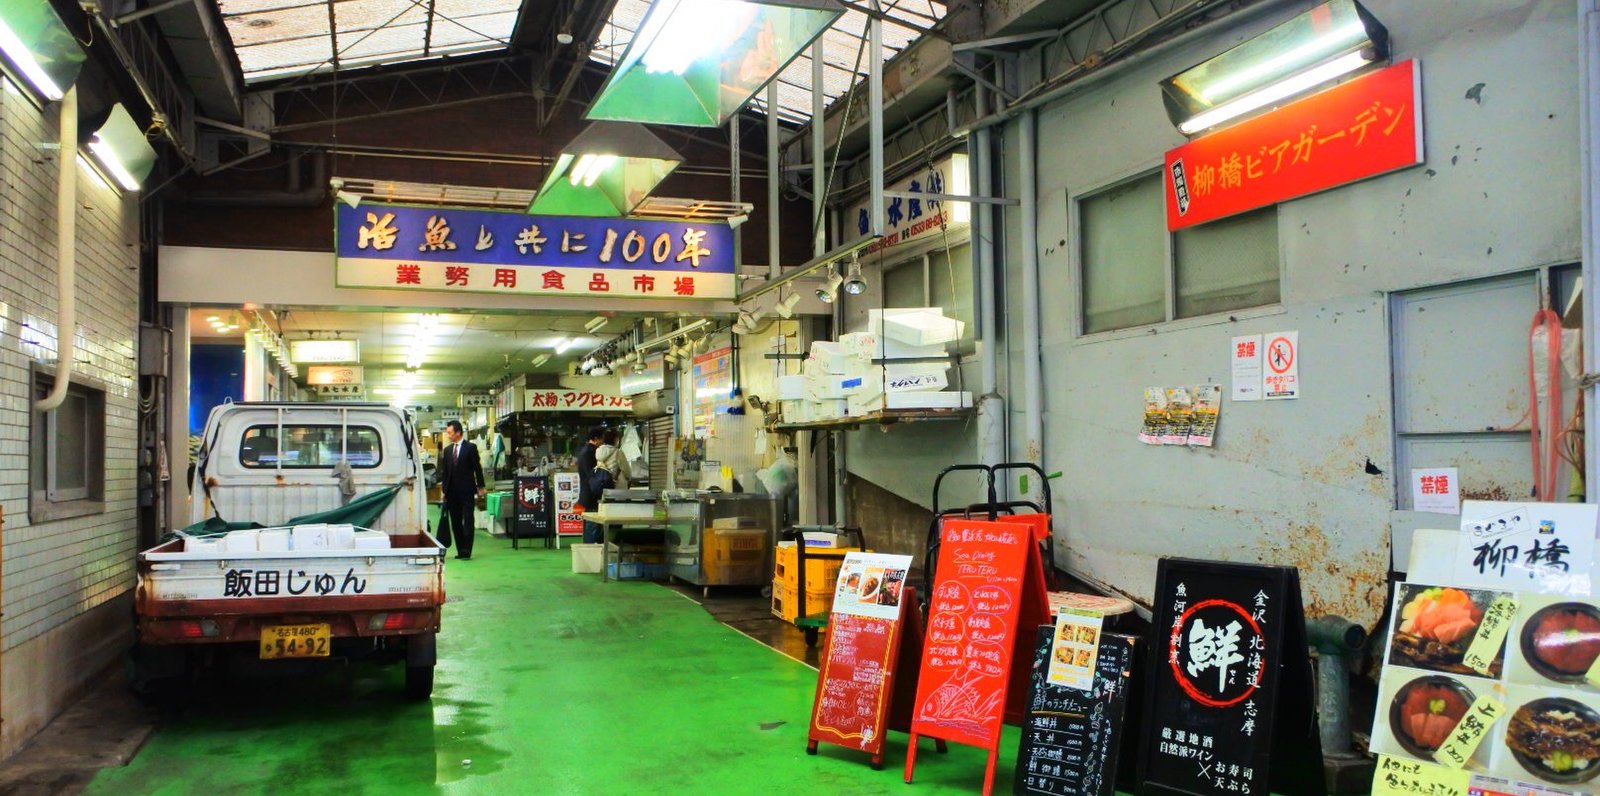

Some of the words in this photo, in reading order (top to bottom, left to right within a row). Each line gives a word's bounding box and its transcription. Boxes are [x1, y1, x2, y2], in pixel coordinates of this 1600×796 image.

[1192, 101, 1405, 196] 柳橋ビアガーデン
[396, 264, 696, 296] 業務用食品市場
[1237, 341, 1255, 358] 禁煙
[1420, 475, 1448, 494] 禁煙
[1473, 538, 1570, 577] 柳橋
[223, 567, 366, 597] 飯田じゅん
[1252, 589, 1270, 624] 金沢
[275, 637, 326, 657] 54-92
[1186, 618, 1245, 693] 鮮
[1246, 634, 1265, 689] 北海道
[1465, 653, 1487, 669] 1500
[1240, 699, 1258, 737] 志摩
[1161, 726, 1214, 749] 厳選地酒
[1159, 741, 1213, 762] 自然派ワイン
[1215, 761, 1253, 781] お寿司
[1214, 775, 1251, 795] 天ぷら
